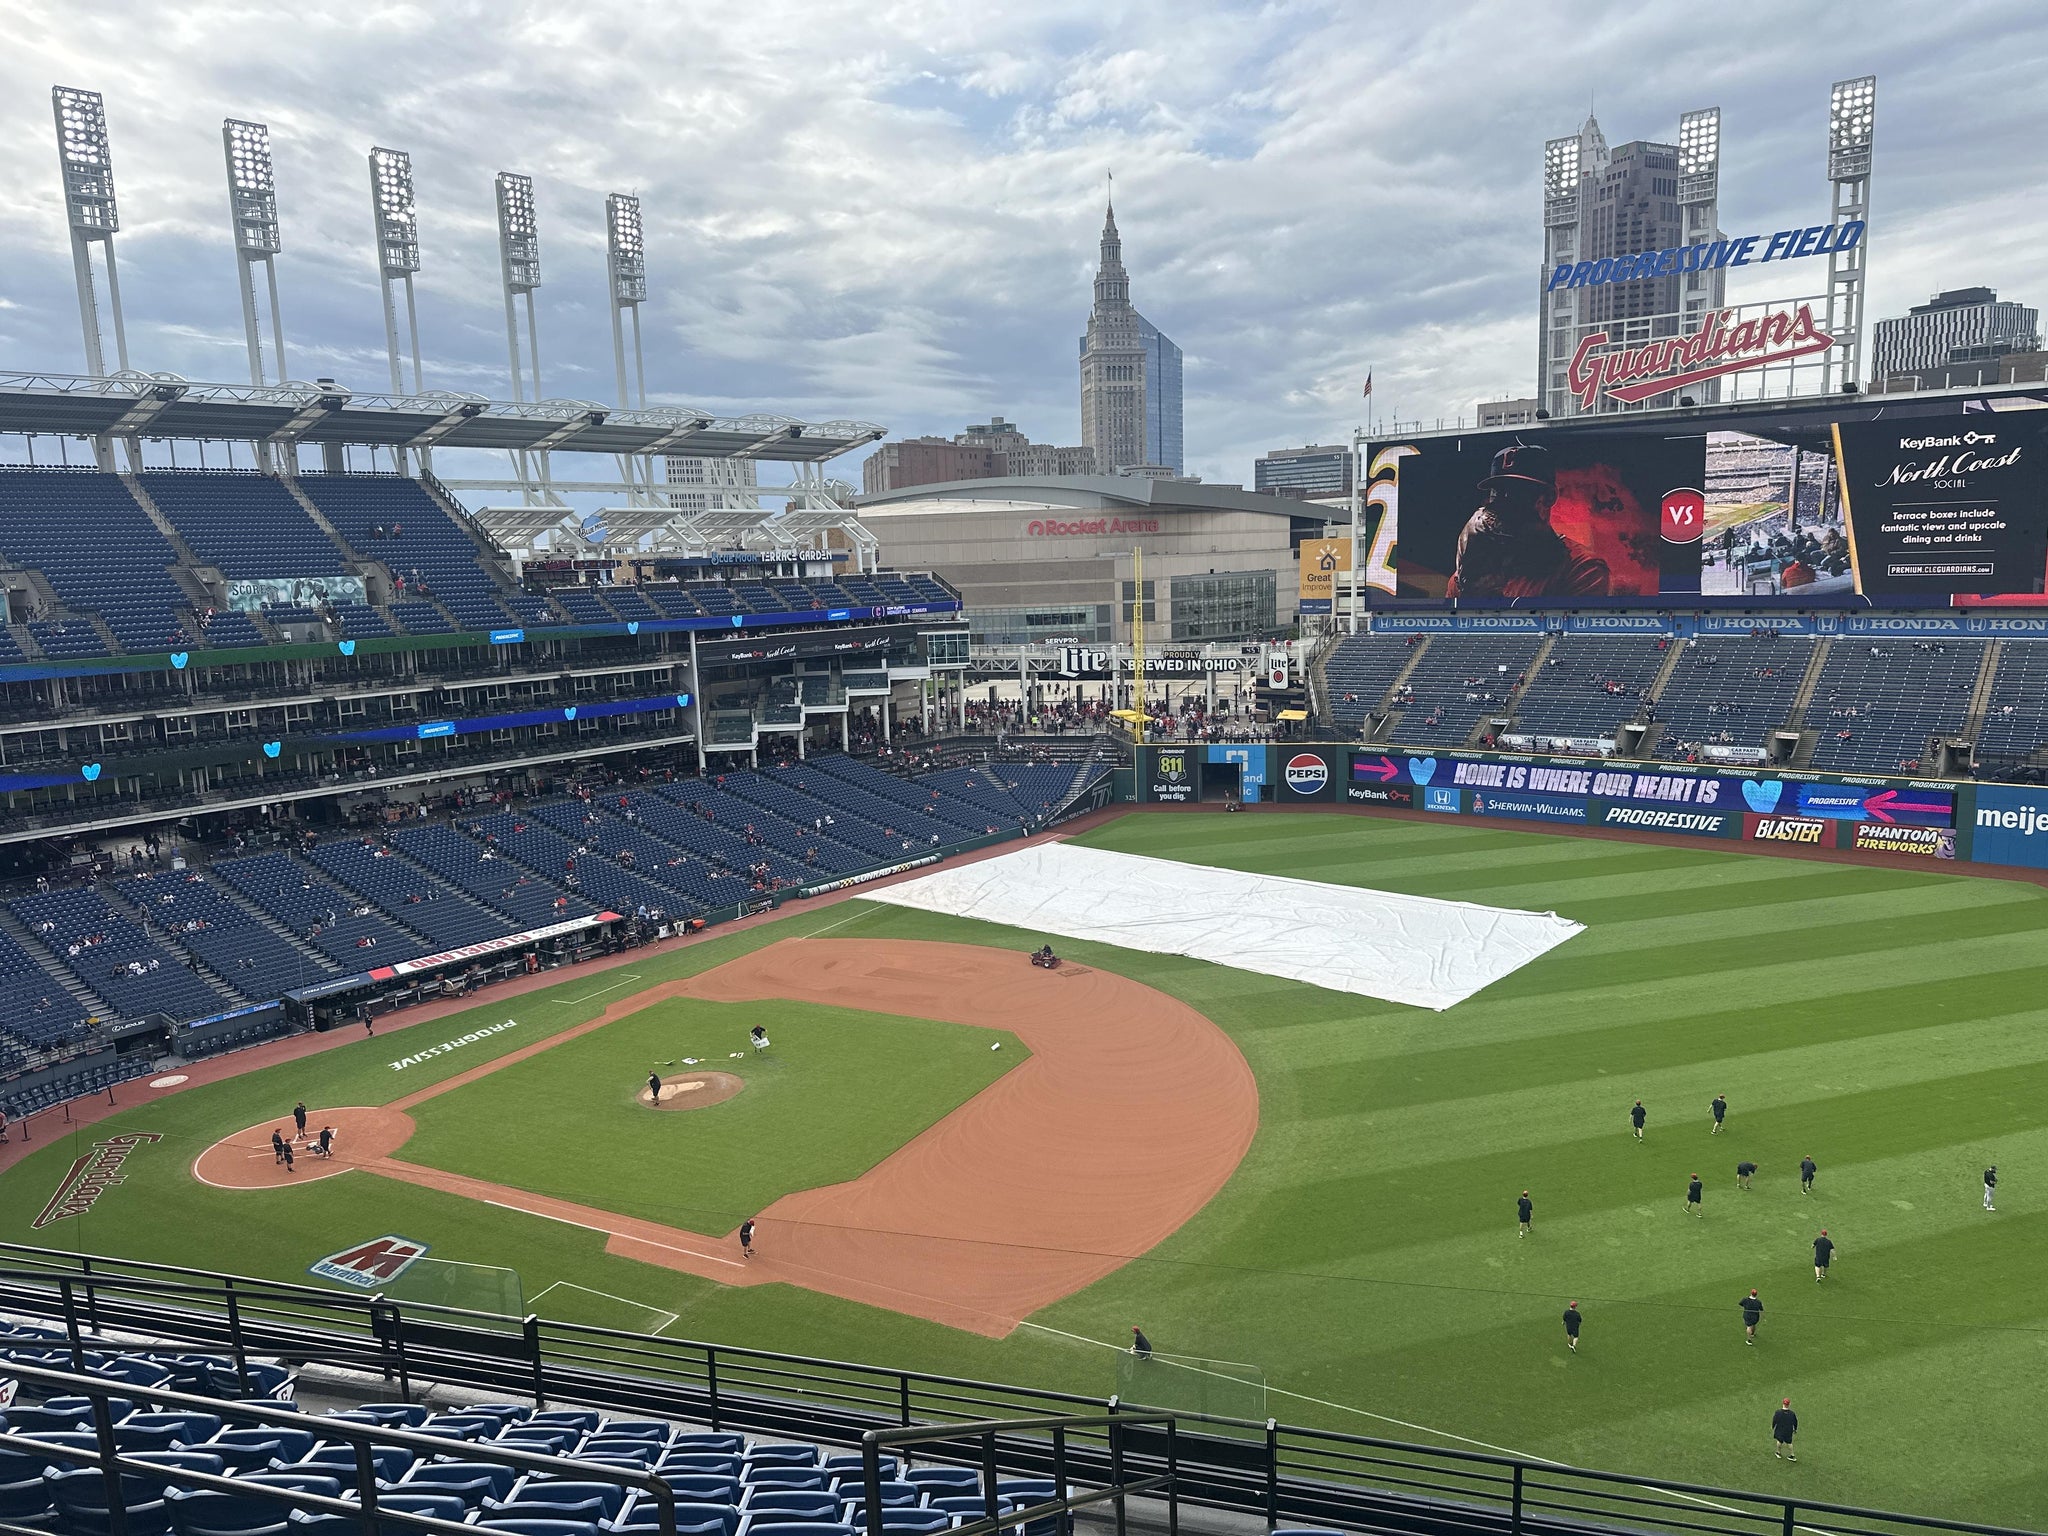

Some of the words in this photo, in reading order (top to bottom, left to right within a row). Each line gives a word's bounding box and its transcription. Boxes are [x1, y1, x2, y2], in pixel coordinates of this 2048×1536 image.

[1646, 144, 1673, 156] Huntington
[1547, 235, 1760, 292] PROGRESSIVE
[1761, 220, 1865, 262] FIELD
[1567, 303, 1835, 411] Guardians
[1900, 435, 1961, 450] KeyBank
[1874, 455, 1951, 487] North
[1951, 446, 2022, 475] Coast
[1934, 479, 1966, 489] SOCIAL
[1668, 504, 1693, 526] VS
[1892, 511, 1928, 520] Terrace
[1929, 510, 1957, 519] boxes
[1959, 508, 1996, 518] include
[1046, 519, 1106, 536] Rocket
[1110, 518, 1159, 534] Arena
[1880, 524, 1919, 532] fantastic
[1921, 522, 1945, 531] views
[1947, 521, 1967, 530] and
[1969, 520, 2007, 531] upscale
[1902, 535, 1931, 545] dining
[1933, 534, 1952, 543] and
[1954, 533, 1982, 542] drinks
[711, 551, 734, 566] BLUE
[734, 552, 757, 563] MOON
[760, 550, 798, 562] TERRACE
[799, 549, 833, 561] GARDEN
[1307, 573, 1332, 582] Great
[1392, 618, 1452, 628] HONDA
[1472, 618, 1538, 627] HONDA
[1590, 617, 1662, 628] HONDA
[1722, 618, 1804, 629] HONDA
[1869, 619, 1960, 630] HONDA
[1989, 619, 2048, 631] HON
[1164, 651, 1200, 659] PROUDLY
[1058, 647, 1107, 678] Lite
[1127, 659, 1184, 671] BREWED
[1187, 659, 1201, 671] IN
[1205, 659, 1237, 671] OHIO
[1271, 658, 1287, 670] Lite
[1403, 748, 1436, 756] PROGRESSIVE
[1449, 751, 1485, 759] PROGRESSIVE
[1498, 754, 1534, 762] PROGRESSIVE
[1160, 757, 1183, 773] 811
[1602, 761, 1642, 769] PROGRESSIVE
[1658, 764, 1698, 773] PROGRESSIVE
[1288, 769, 1326, 779] PEPSI
[1716, 768, 1758, 777] PROGRESSIVE
[1777, 772, 1821, 780] PROGRESSIVE
[1453, 762, 1505, 787] HOME
[1506, 765, 1527, 789] IS
[1528, 767, 1592, 795] WHERE
[1593, 773, 1633, 797] OUR
[1633, 775, 1696, 802] HEART
[1695, 779, 1720, 804] IS
[1841, 776, 1887, 786] PROGRESSIVE
[1908, 781, 1957, 790] PROGRESSIVE
[1153, 784, 1167, 792] Call
[1168, 784, 1191, 792] before
[1348, 787, 1388, 800] KeyBank
[1159, 793, 1172, 801] you
[1173, 792, 1186, 801] dig.
[1807, 797, 1859, 806] PROGRESSIVE
[1427, 803, 1457, 811] HONDA
[1605, 807, 1725, 832] PROGRESSIVE
[1754, 819, 1824, 843] BLASTER
[1858, 825, 1938, 843] PHANTOM
[1856, 838, 1936, 855] FIREWORKS
[407, 933, 533, 970] CLEVELAND
[121, 1019, 146, 1030] LEXUS
[388, 1019, 517, 1072] PROGRESSIVE
[31, 1132, 164, 1230] Guardians
[314, 1263, 378, 1286] Marathon
